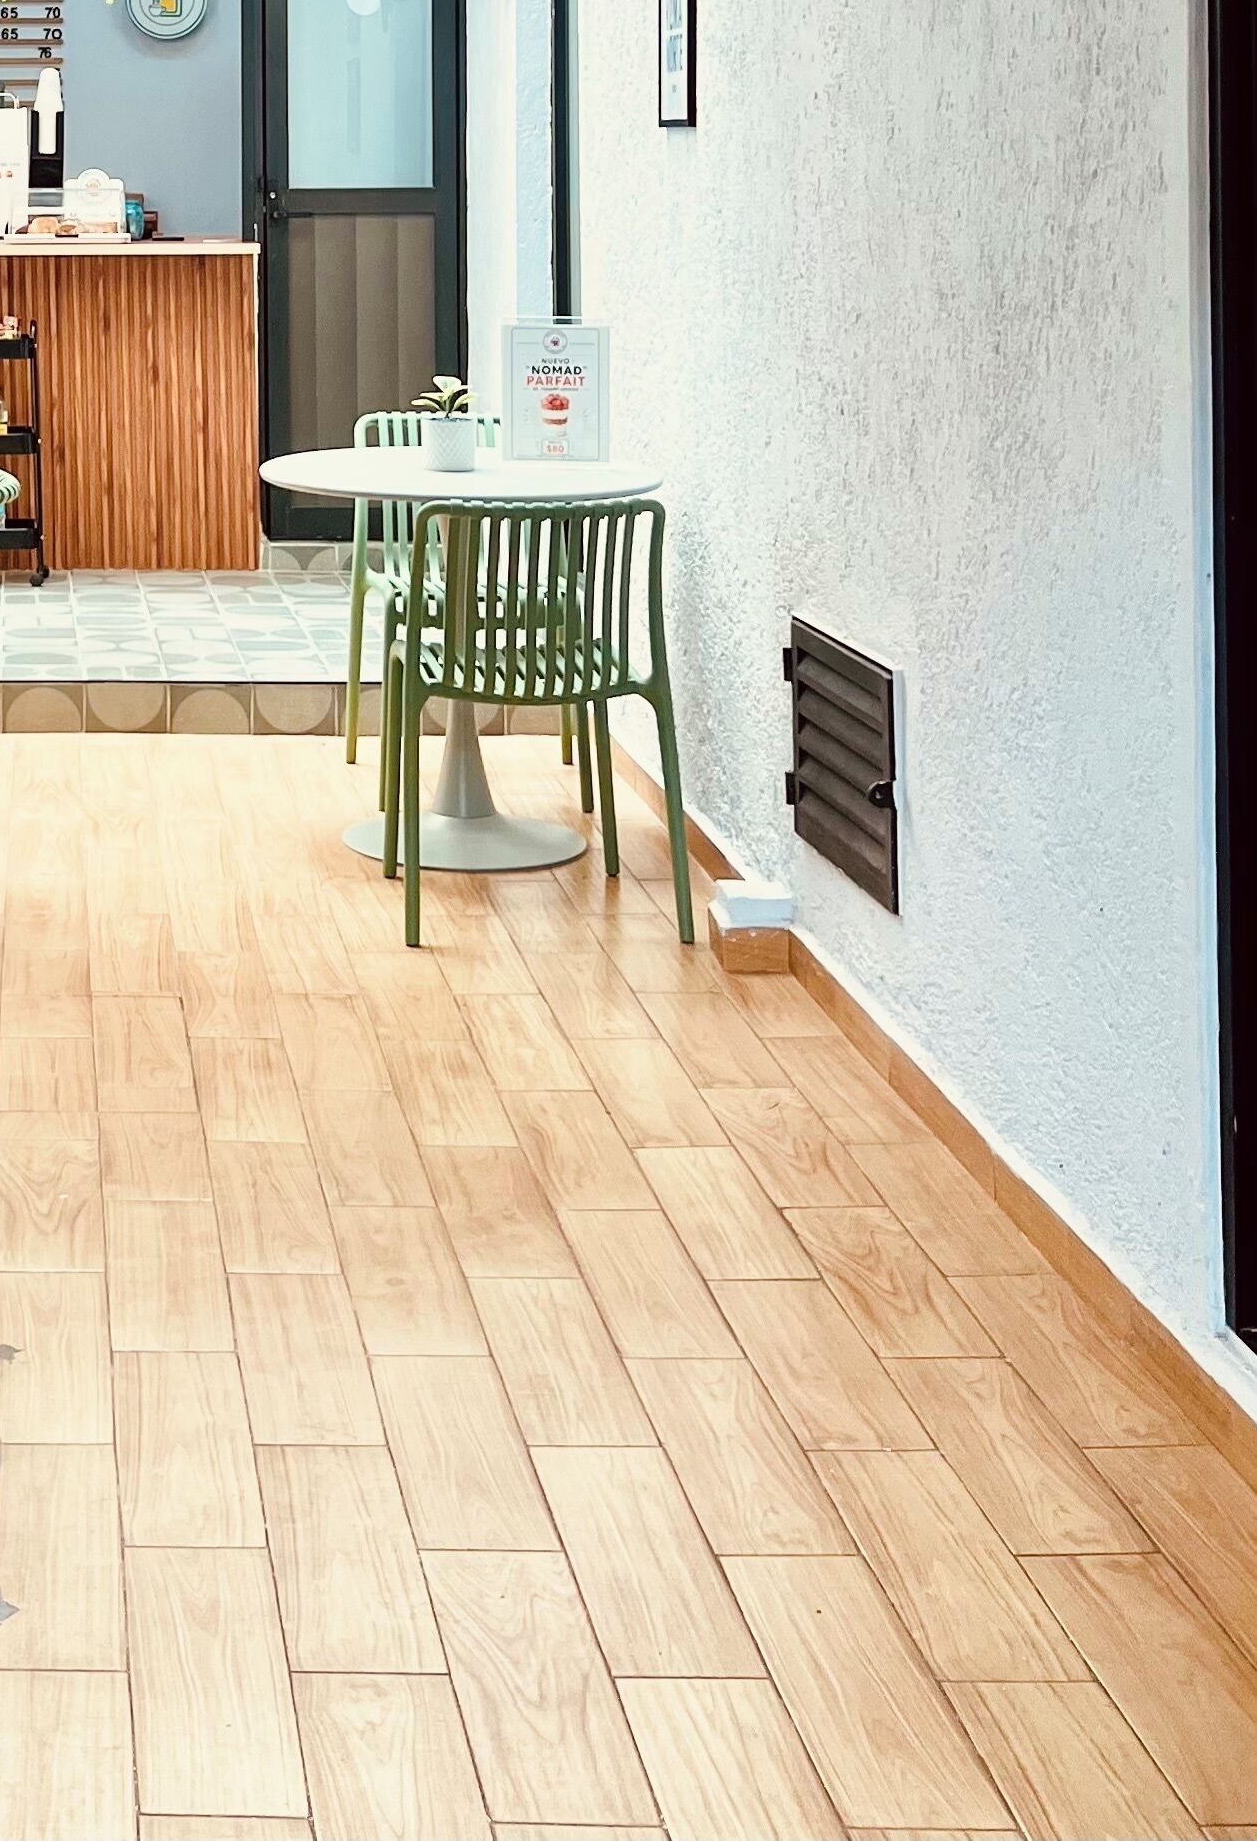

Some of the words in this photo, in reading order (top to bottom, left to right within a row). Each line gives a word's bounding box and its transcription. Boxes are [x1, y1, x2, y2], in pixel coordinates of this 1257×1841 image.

[0, 7, 19, 19] 65
[45, 7, 61, 19] 70
[1, 28, 19, 40] 65
[38, 47, 52, 59] 76
[526, 376, 586, 386] PARFAIT
